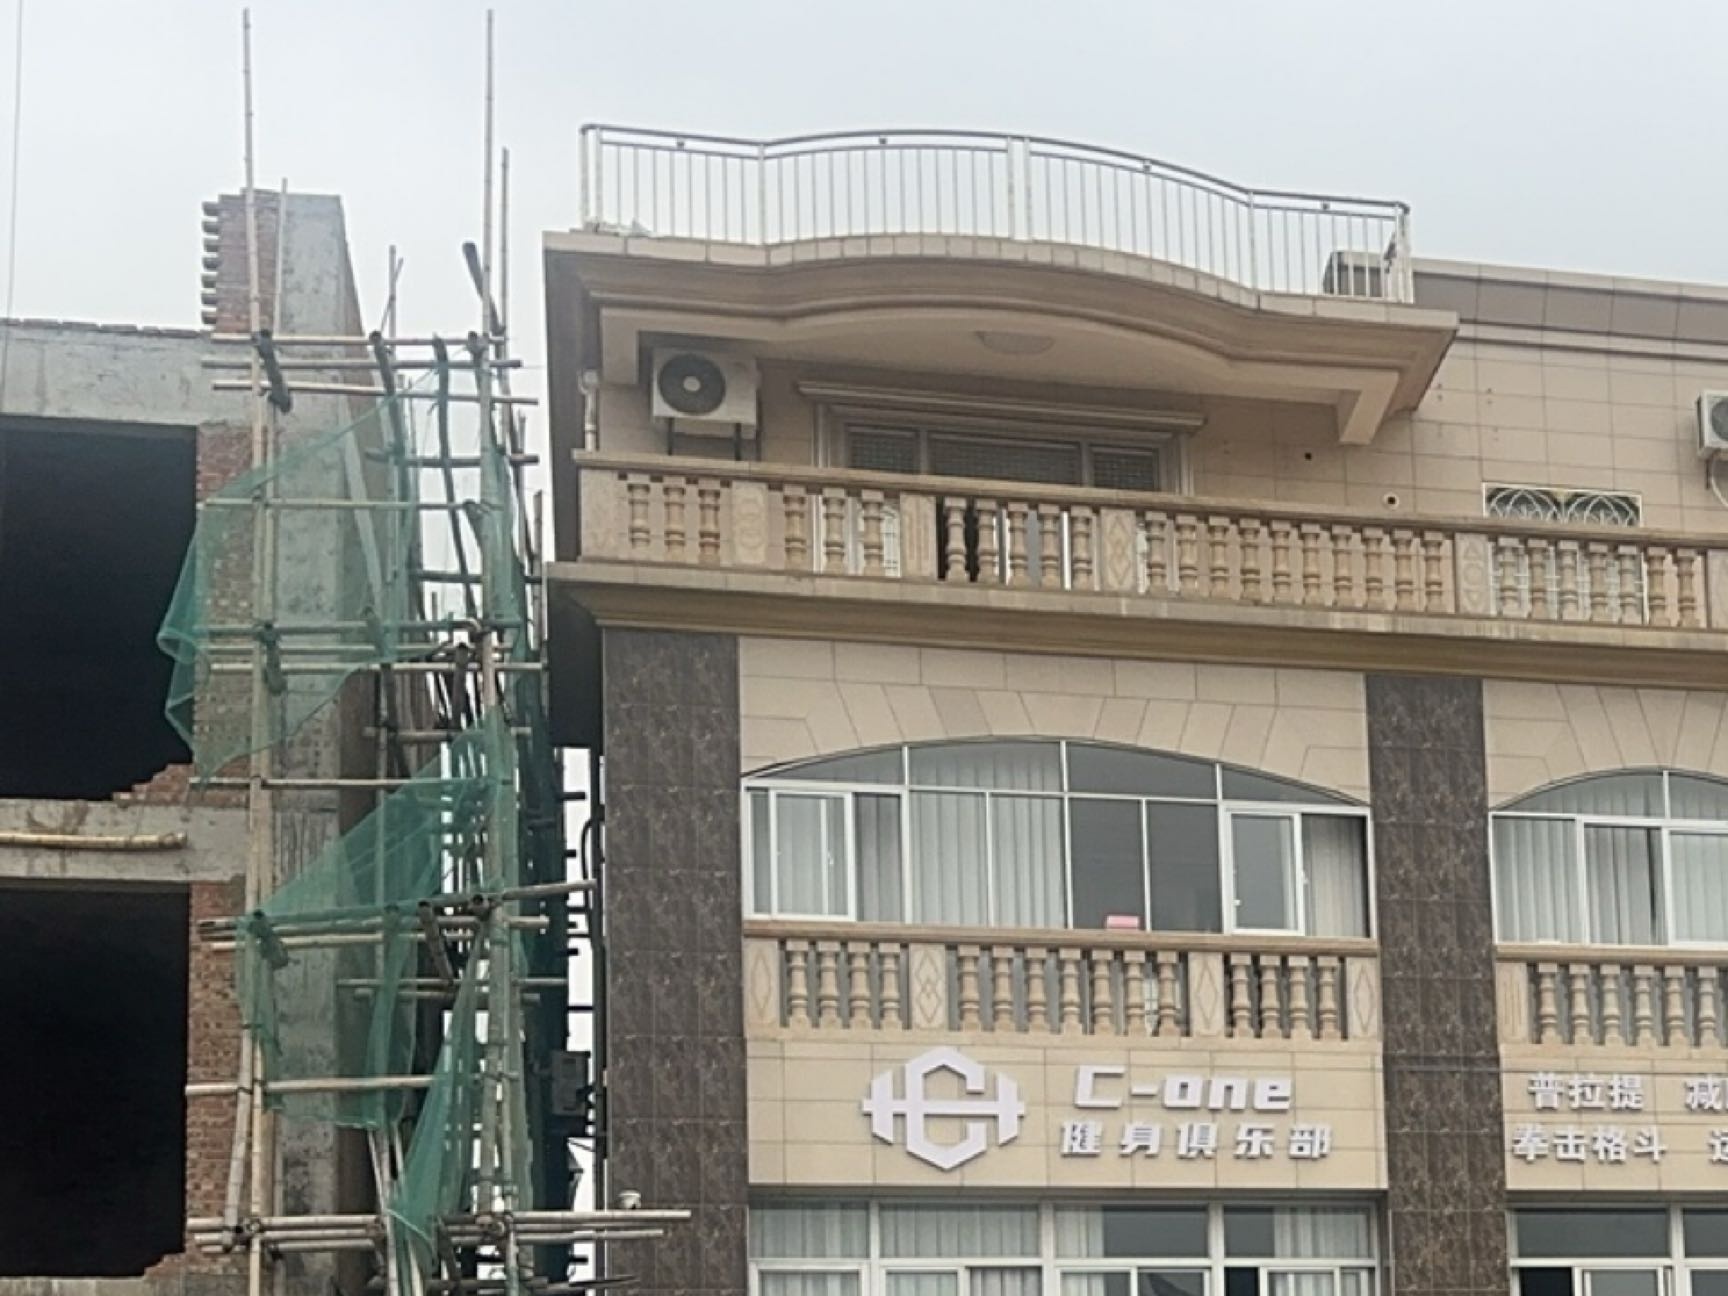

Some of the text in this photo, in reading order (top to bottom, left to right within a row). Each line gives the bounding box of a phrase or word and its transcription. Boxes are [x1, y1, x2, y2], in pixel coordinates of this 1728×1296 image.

[1075, 1064, 1293, 1110] C-one
[1528, 1072, 1645, 1111] 普拉提
[1060, 1121, 1333, 1160] 健身俱乐部
[1511, 1123, 1668, 1162] 拳击格斗
